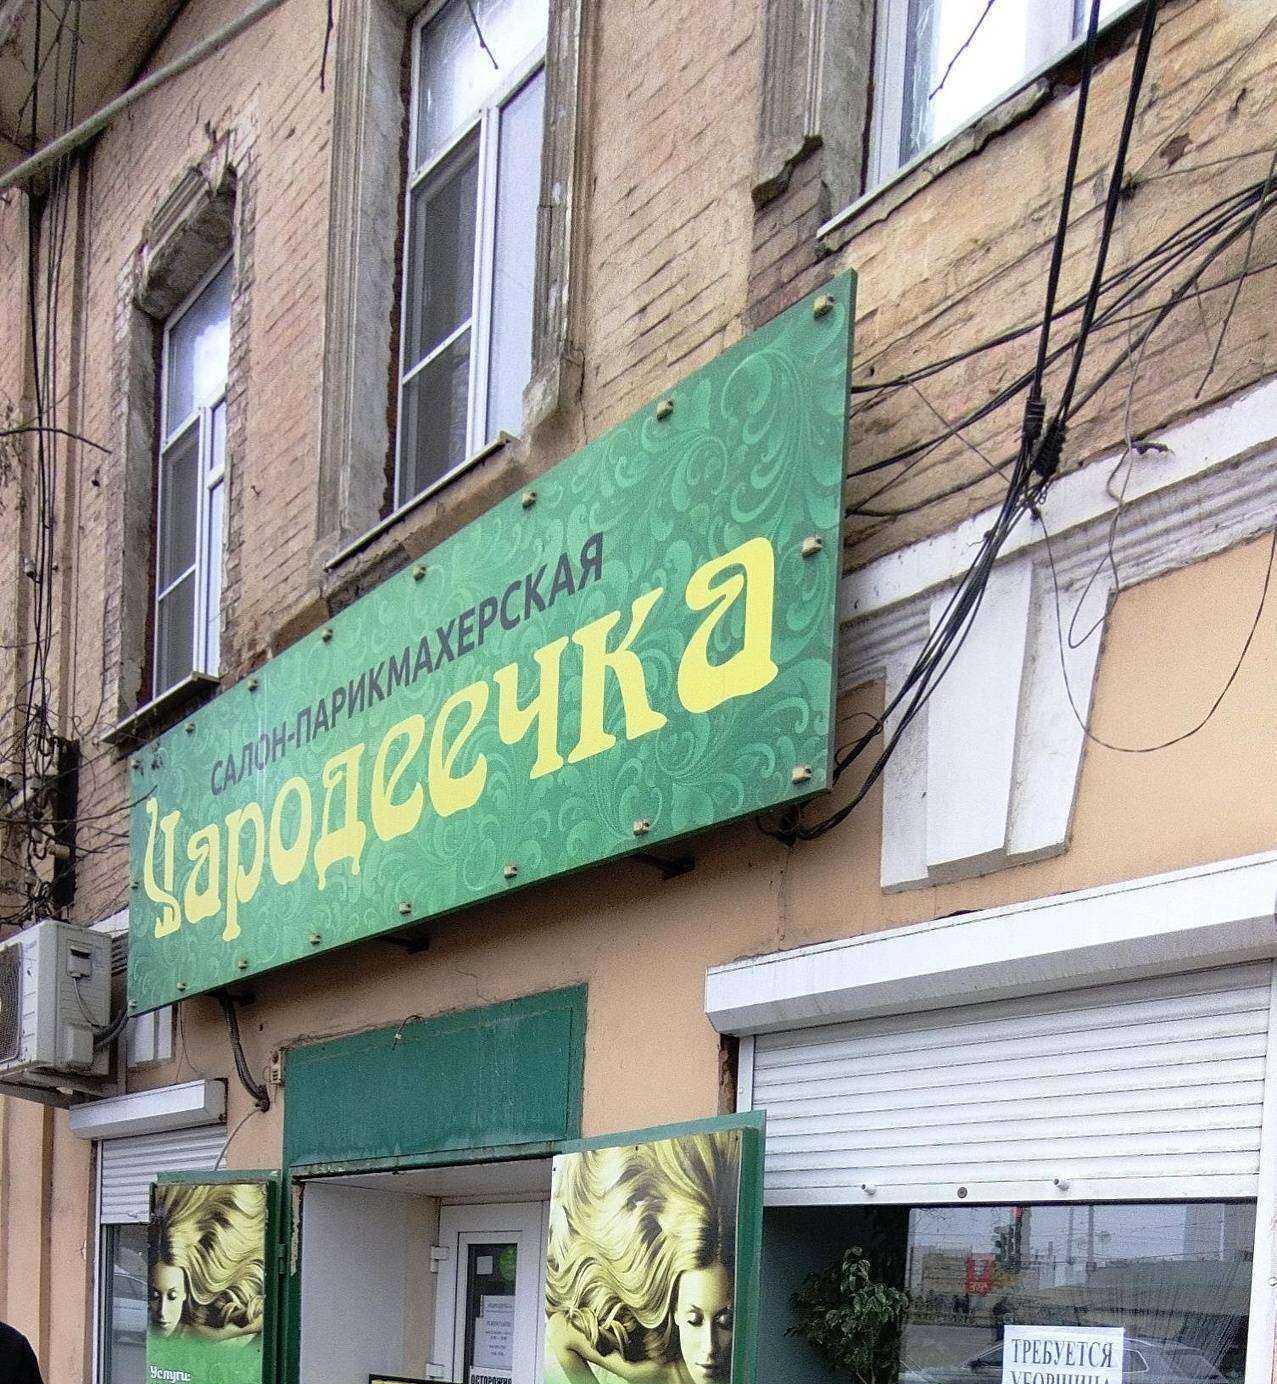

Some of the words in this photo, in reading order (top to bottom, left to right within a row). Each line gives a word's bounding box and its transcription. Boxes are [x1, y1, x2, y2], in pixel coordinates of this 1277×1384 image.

[210, 531, 606, 797] САЛОН-ПАРИКМАХЕРСКАЯ
[144, 537, 778, 942] Чародеечка
[150, 1365, 191, 1383] Услуги:
[1011, 1339, 1113, 1368] ТРЕБУЕТСЯ
